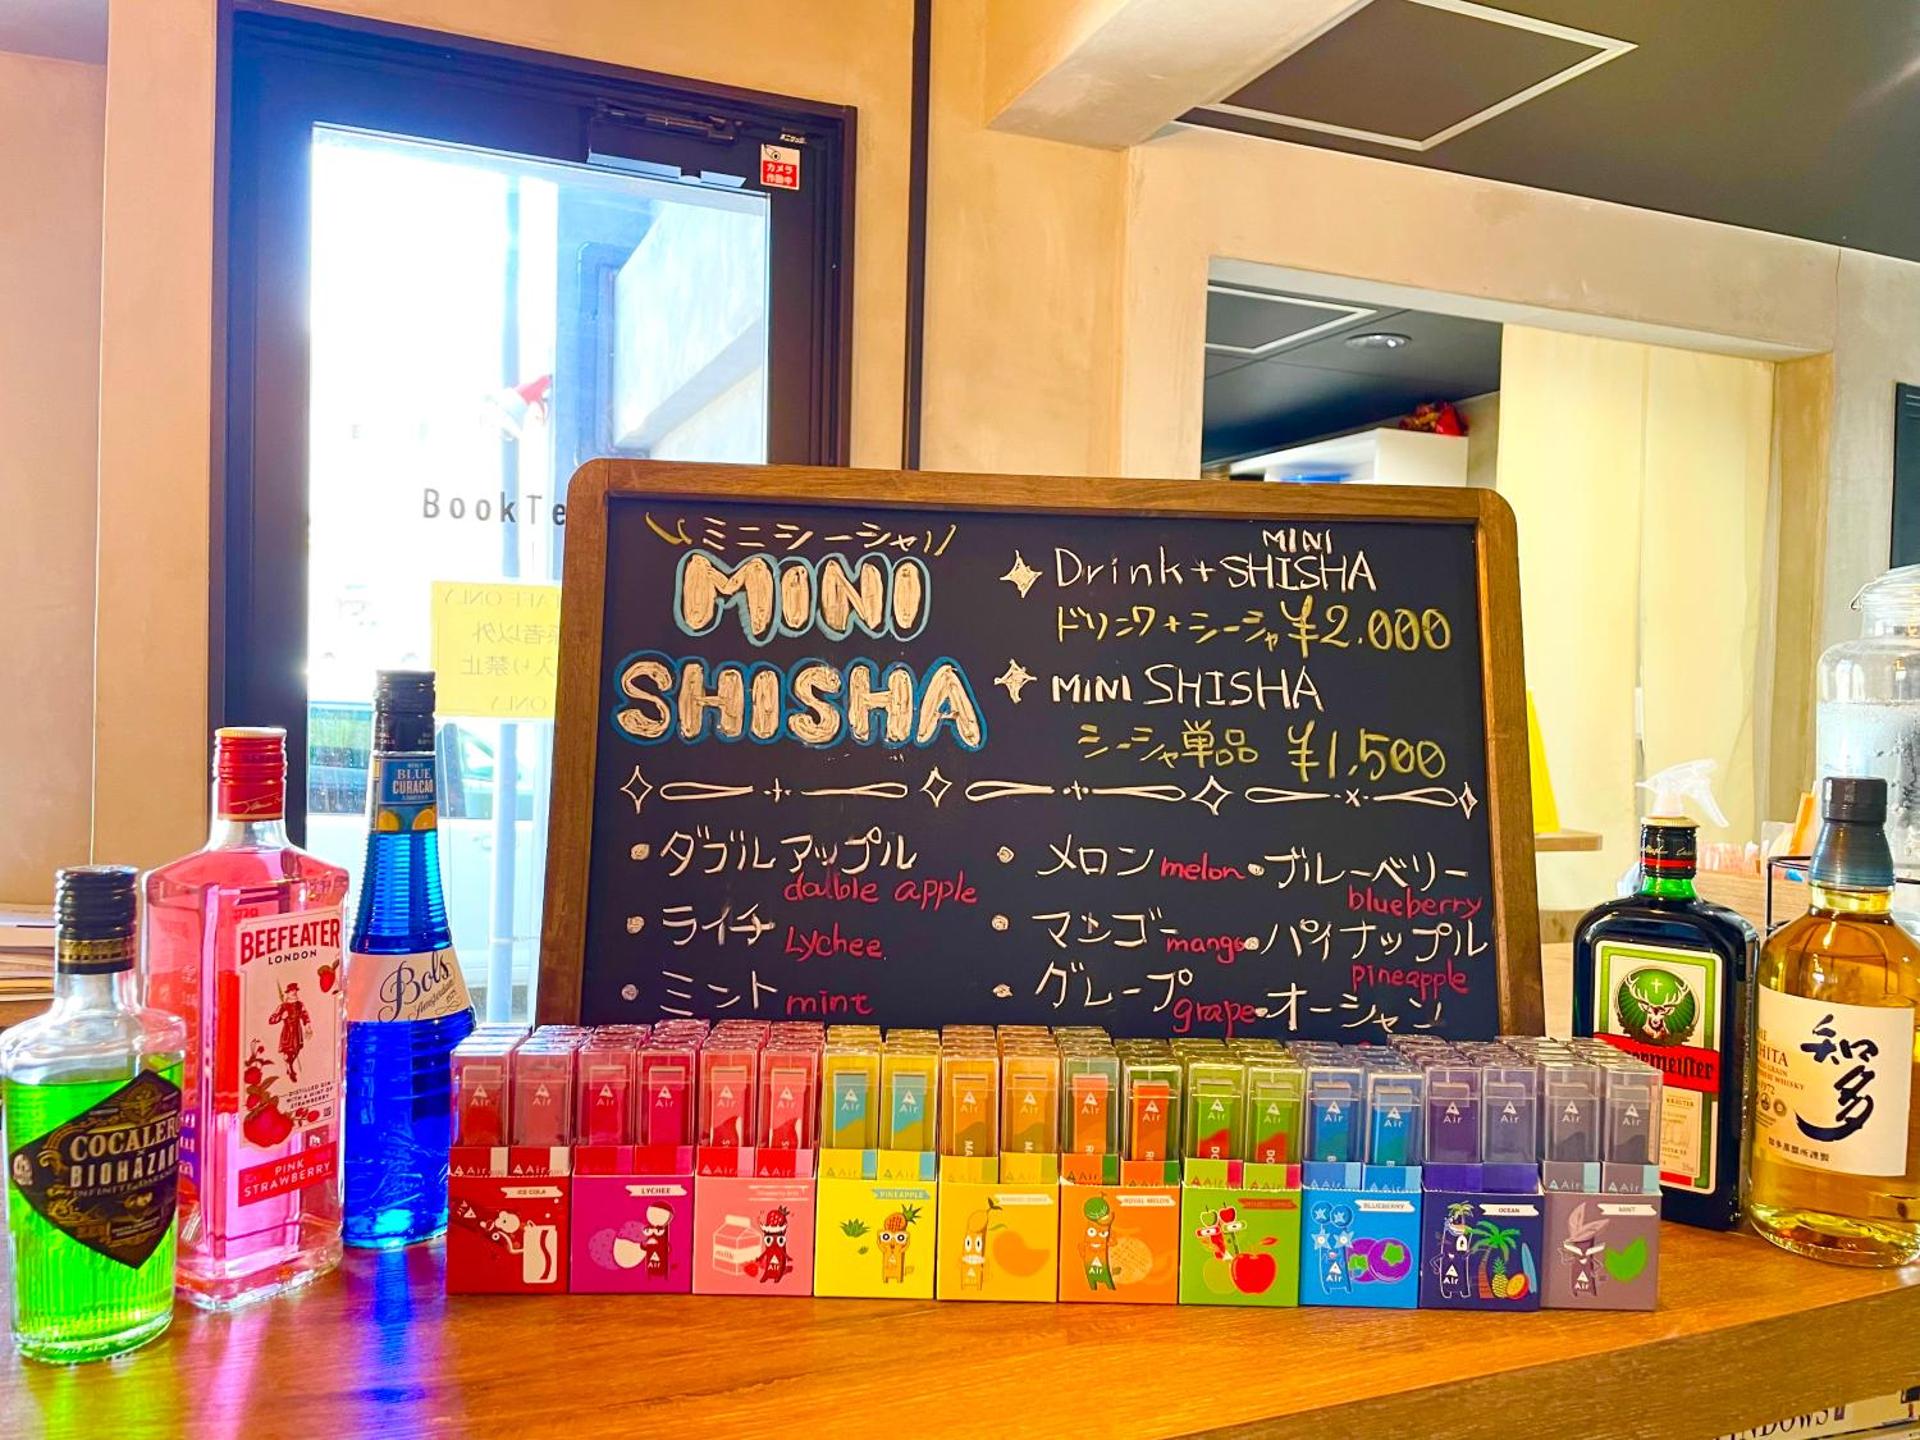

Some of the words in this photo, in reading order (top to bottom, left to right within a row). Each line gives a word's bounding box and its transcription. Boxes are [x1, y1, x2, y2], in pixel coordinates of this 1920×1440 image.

[1262, 528, 1333, 554] MINI
[675, 549, 931, 646] MINI
[1052, 674, 1133, 703] MINI
[1144, 663, 1324, 711] SHISHA
[613, 650, 988, 750] SHISHA
[397, 767, 431, 779] BLUE
[1036, 834, 1156, 878] メロン
[1160, 852, 1247, 883] melon
[1264, 847, 1469, 892] ブルーベリー
[894, 870, 977, 911] apple
[1347, 884, 1483, 919] blueberry
[662, 904, 776, 946] ライチ
[240, 918, 340, 966] BEEFEATER
[1260, 918, 1489, 963] パイナップル
[268, 949, 318, 966] LONDON
[1351, 958, 1471, 1002] pineapple
[378, 951, 450, 1023] Bols
[1035, 960, 1194, 1013] グレープ
[660, 970, 778, 1017] ミント
[785, 990, 874, 1016] mint
[1171, 998, 1257, 1039] grape
[1758, 1042, 1788, 1068] HITA
[1774, 1076, 1804, 1091] WHISKY
[471, 1098, 490, 1107] Air
[532, 1098, 552, 1106] Air
[596, 1098, 614, 1106] Air
[655, 1099, 673, 1108] Air
[717, 1099, 736, 1108] Air
[777, 1100, 796, 1109] Air
[841, 1103, 860, 1112] Air
[899, 1104, 919, 1113] Air
[960, 1105, 979, 1113] Air
[1020, 1105, 1039, 1114] Air
[1081, 1106, 1100, 1115] Air
[1142, 1113, 1161, 1122] Air
[1208, 1111, 1225, 1121] Air
[1264, 1115, 1281, 1124] Air
[1324, 1114, 1344, 1123] Air
[1443, 1115, 1463, 1124] Air
[1500, 1114, 1520, 1124] Air
[1561, 1114, 1581, 1123] Air
[1622, 1117, 1641, 1126] Air
[1384, 1119, 1403, 1128] Air
[275, 1158, 304, 1175] PINK
[244, 1161, 331, 1197] STRAWBERRY
[641, 1187, 671, 1195] LYCHEE
[1088, 1266, 1104, 1275] Air
[1326, 1274, 1343, 1282] Air
[1443, 1276, 1459, 1285] Air
